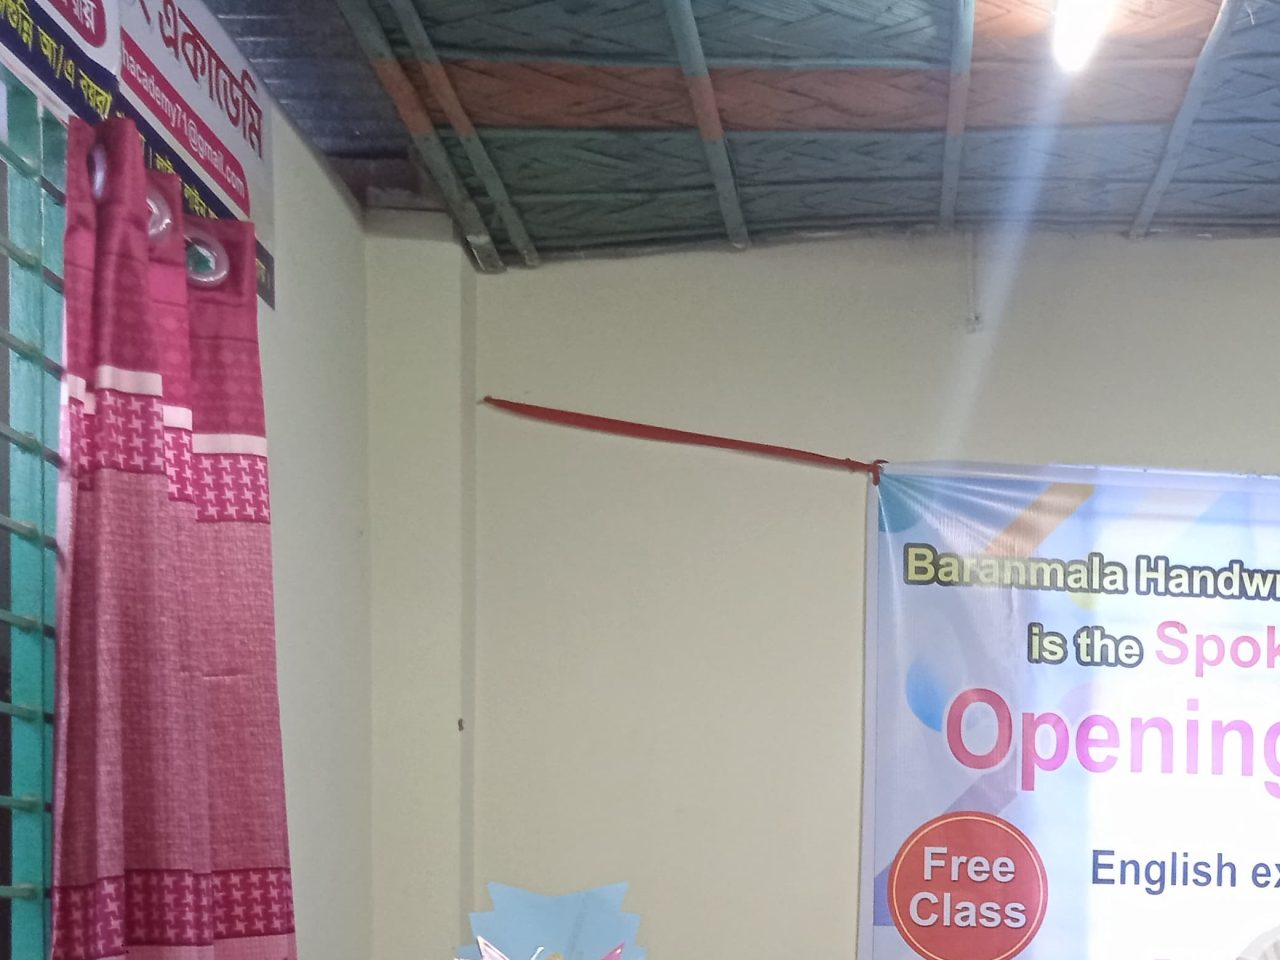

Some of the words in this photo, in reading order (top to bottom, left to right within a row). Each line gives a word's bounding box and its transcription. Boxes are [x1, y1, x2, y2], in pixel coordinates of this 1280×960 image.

[903, 543, 1128, 594] Baranmala
[1027, 622, 1067, 664] is
[1076, 626, 1144, 668] the
[923, 846, 1016, 883] Free
[1091, 849, 1237, 895] English
[908, 892, 1028, 929] Class
